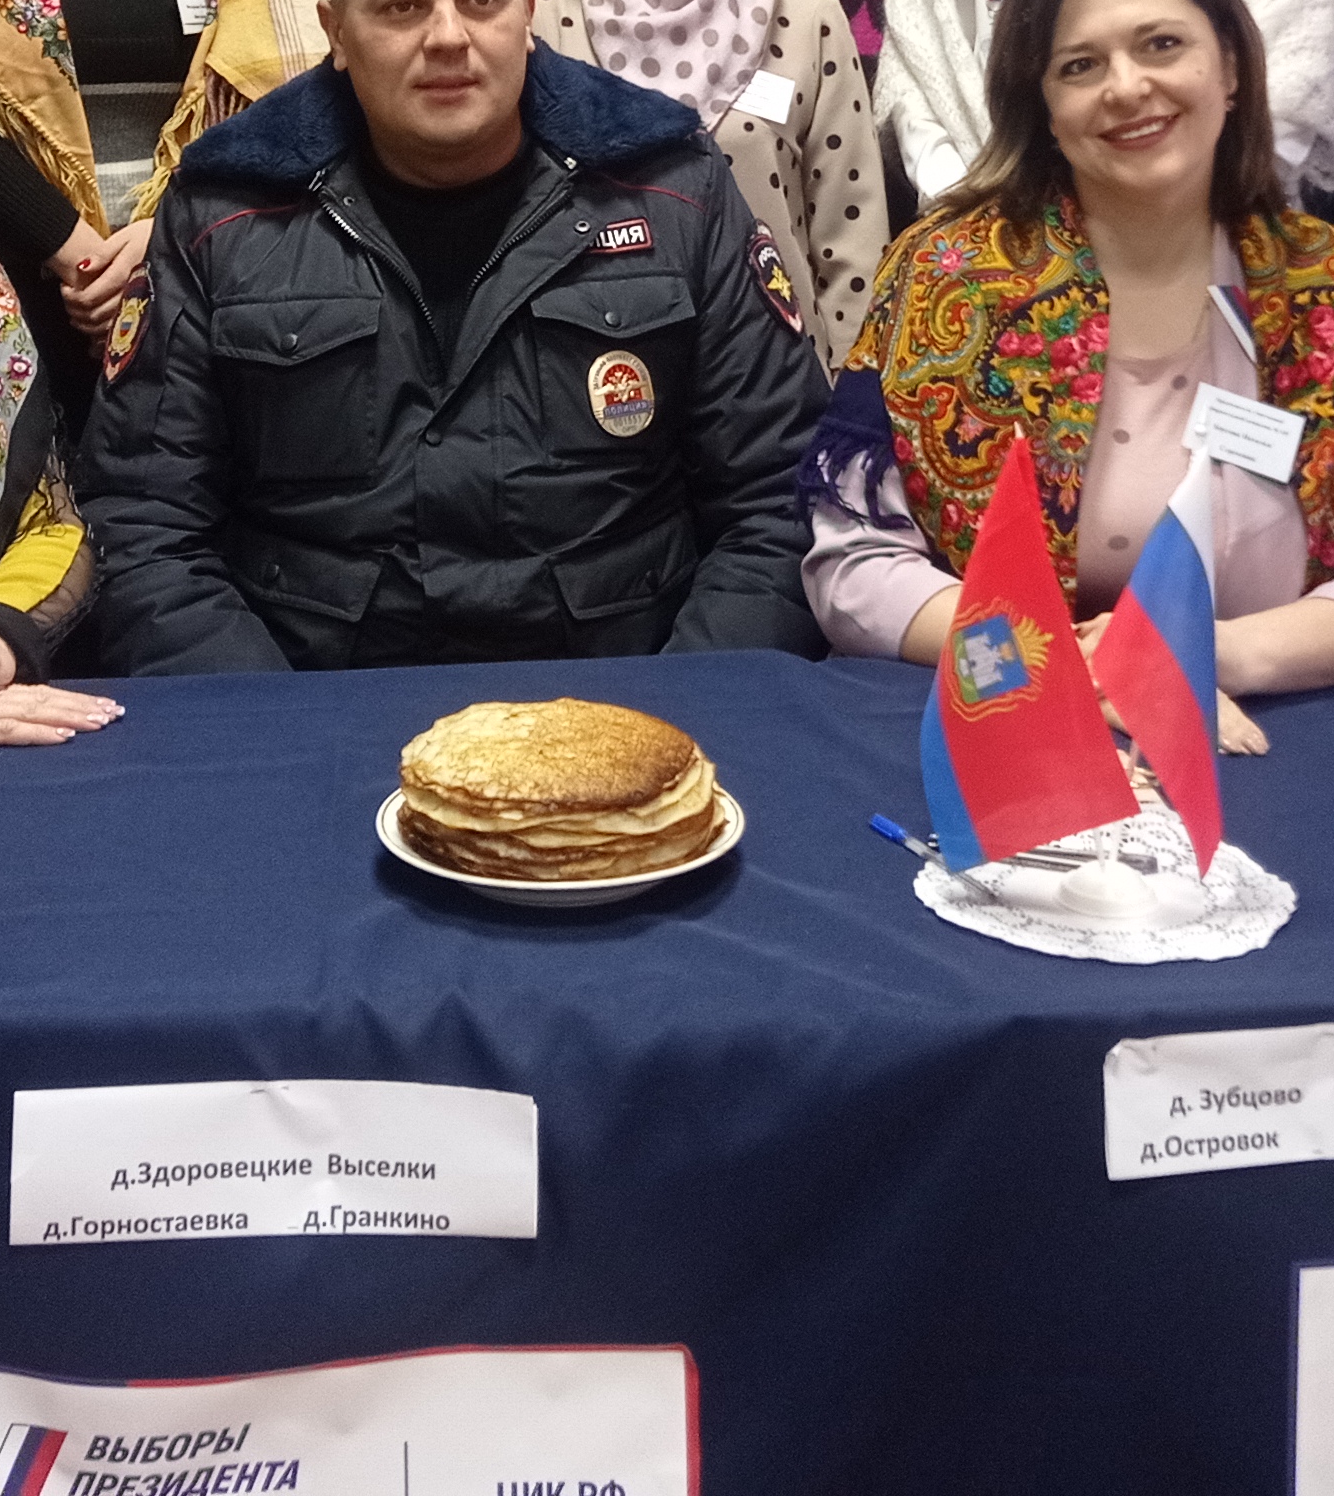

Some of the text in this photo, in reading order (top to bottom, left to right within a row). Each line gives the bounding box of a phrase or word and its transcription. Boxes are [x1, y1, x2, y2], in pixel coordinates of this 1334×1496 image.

[1169, 1095, 1193, 1118] д.
[1200, 1084, 1303, 1114] Зубцово
[110, 1153, 436, 1192] д.Здоровецкие Выселки
[42, 1204, 451, 1241] д.Горностаевка д.Гранкино
[84, 1423, 251, 1464] ВЫБОРЫ
[68, 1458, 301, 1496] ПРЕЗИДЕНТА
